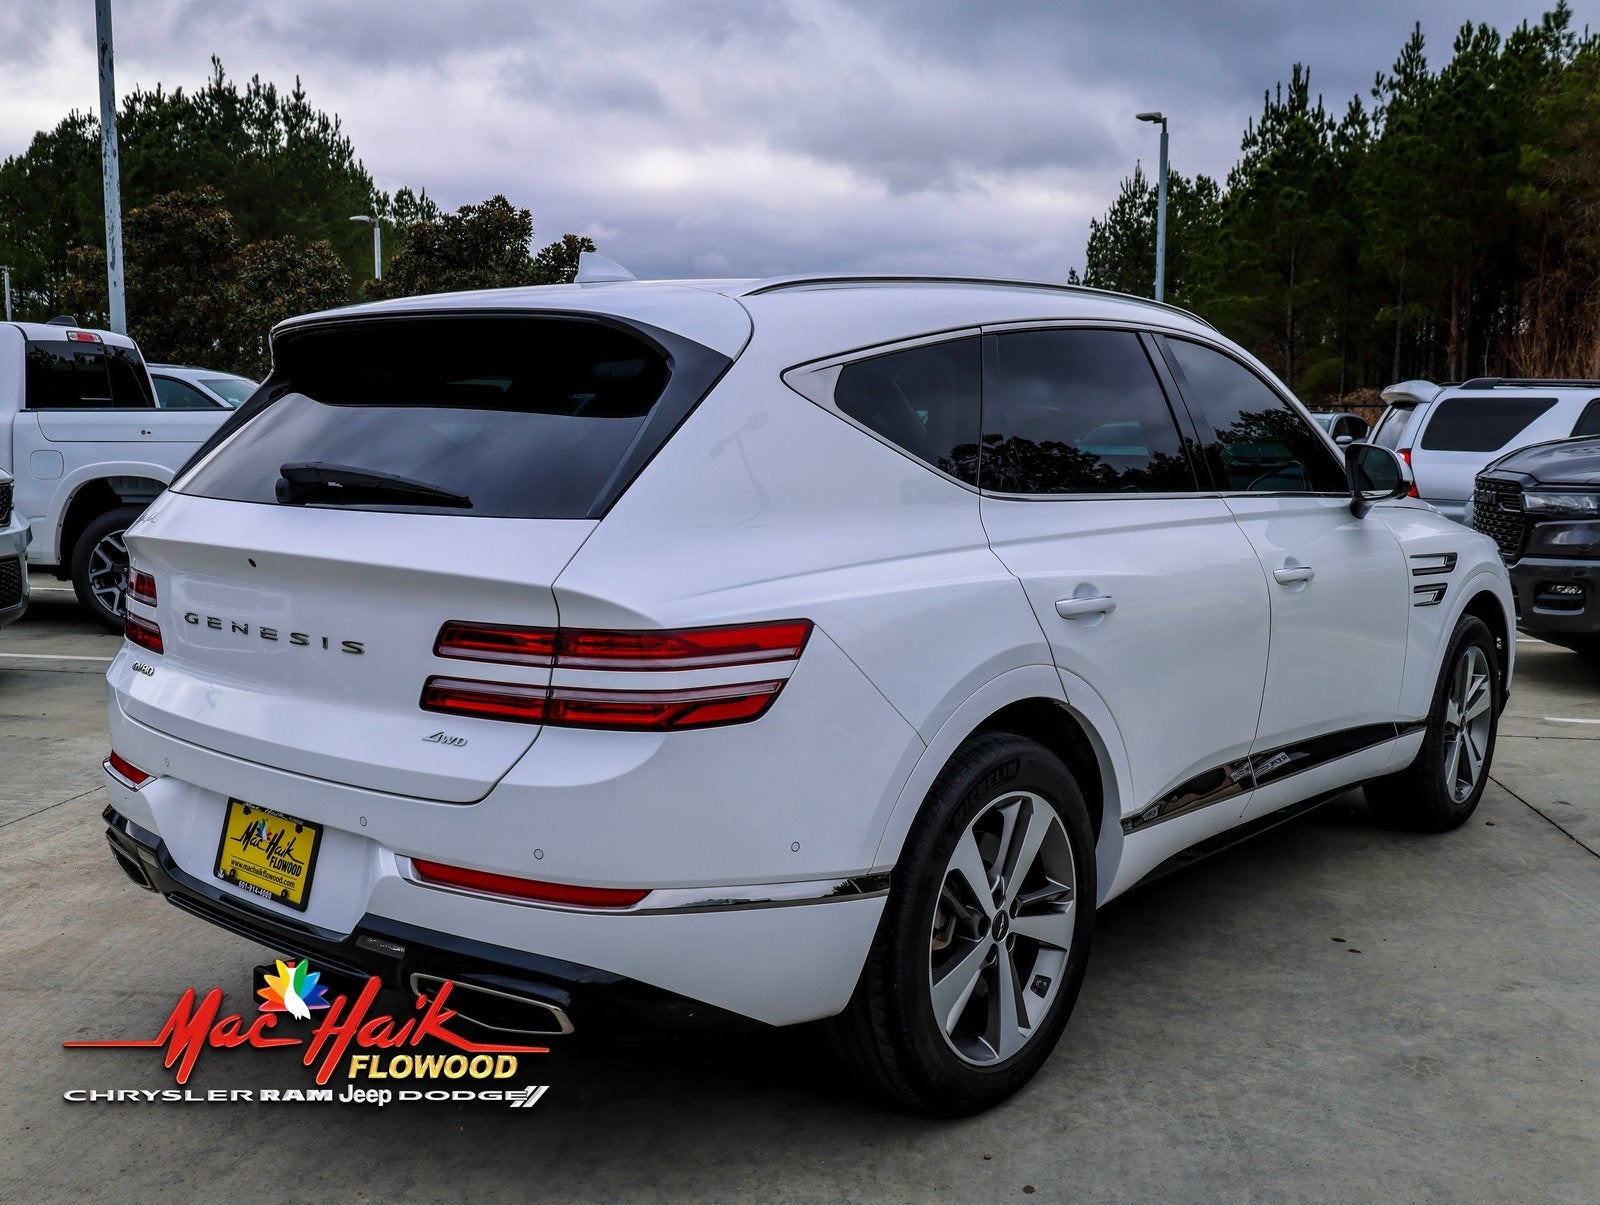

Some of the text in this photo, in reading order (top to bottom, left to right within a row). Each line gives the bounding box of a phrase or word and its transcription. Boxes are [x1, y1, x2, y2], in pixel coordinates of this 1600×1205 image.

[184, 612, 365, 655] GENESIS
[132, 660, 155, 677] GV80
[421, 731, 468, 747] 4WD
[951, 758, 1019, 834] MICHELIN
[230, 820, 304, 865] Mac Haik
[231, 860, 295, 888] www.machaikflowood.com
[269, 856, 302, 877] FLOWOOD
